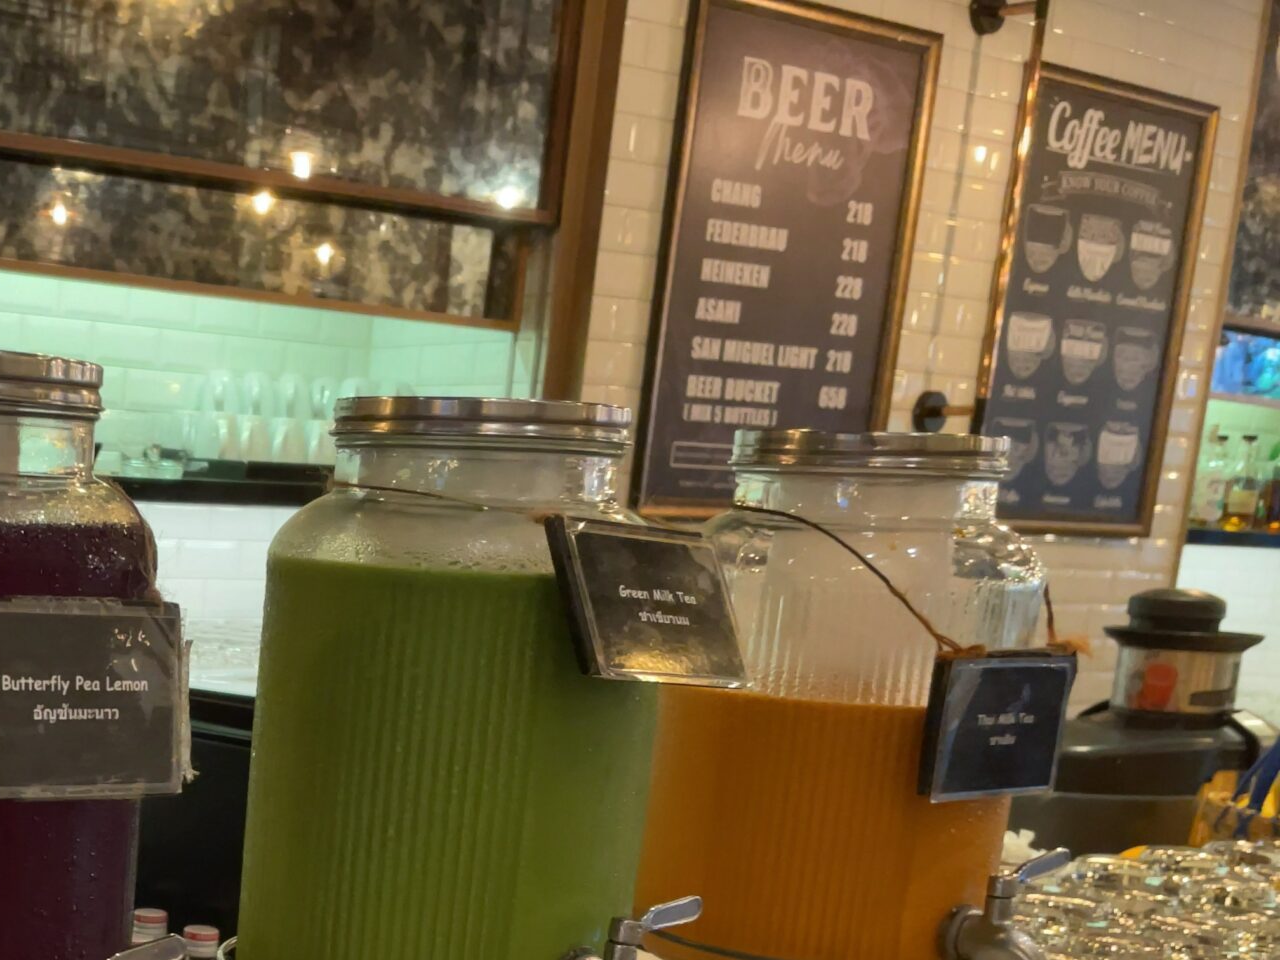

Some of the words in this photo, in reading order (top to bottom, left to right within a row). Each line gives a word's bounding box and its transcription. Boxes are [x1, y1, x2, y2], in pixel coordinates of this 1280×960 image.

[737, 56, 873, 140] BEER
[754, 118, 844, 170] Menu
[1047, 101, 1121, 169] Coffee
[1121, 120, 1187, 175] MENU
[711, 178, 762, 208] CHANG
[700, 258, 770, 289] HEINEKEN
[695, 297, 742, 324] ASAHI
[691, 336, 722, 361] SAN
[723, 339, 775, 366] MIGUEL
[777, 345, 818, 370] LIGHT
[686, 374, 722, 399] BEER
[724, 378, 781, 404] BUCKET
[619, 585, 650, 599] Green
[653, 589, 675, 602] Milk
[676, 592, 697, 604] Tea
[1, 675, 70, 696] Butterfly
[75, 675, 101, 691] Pea
[106, 676, 149, 692] Lemon
[33, 703, 120, 723] อัญชันมะนาว
